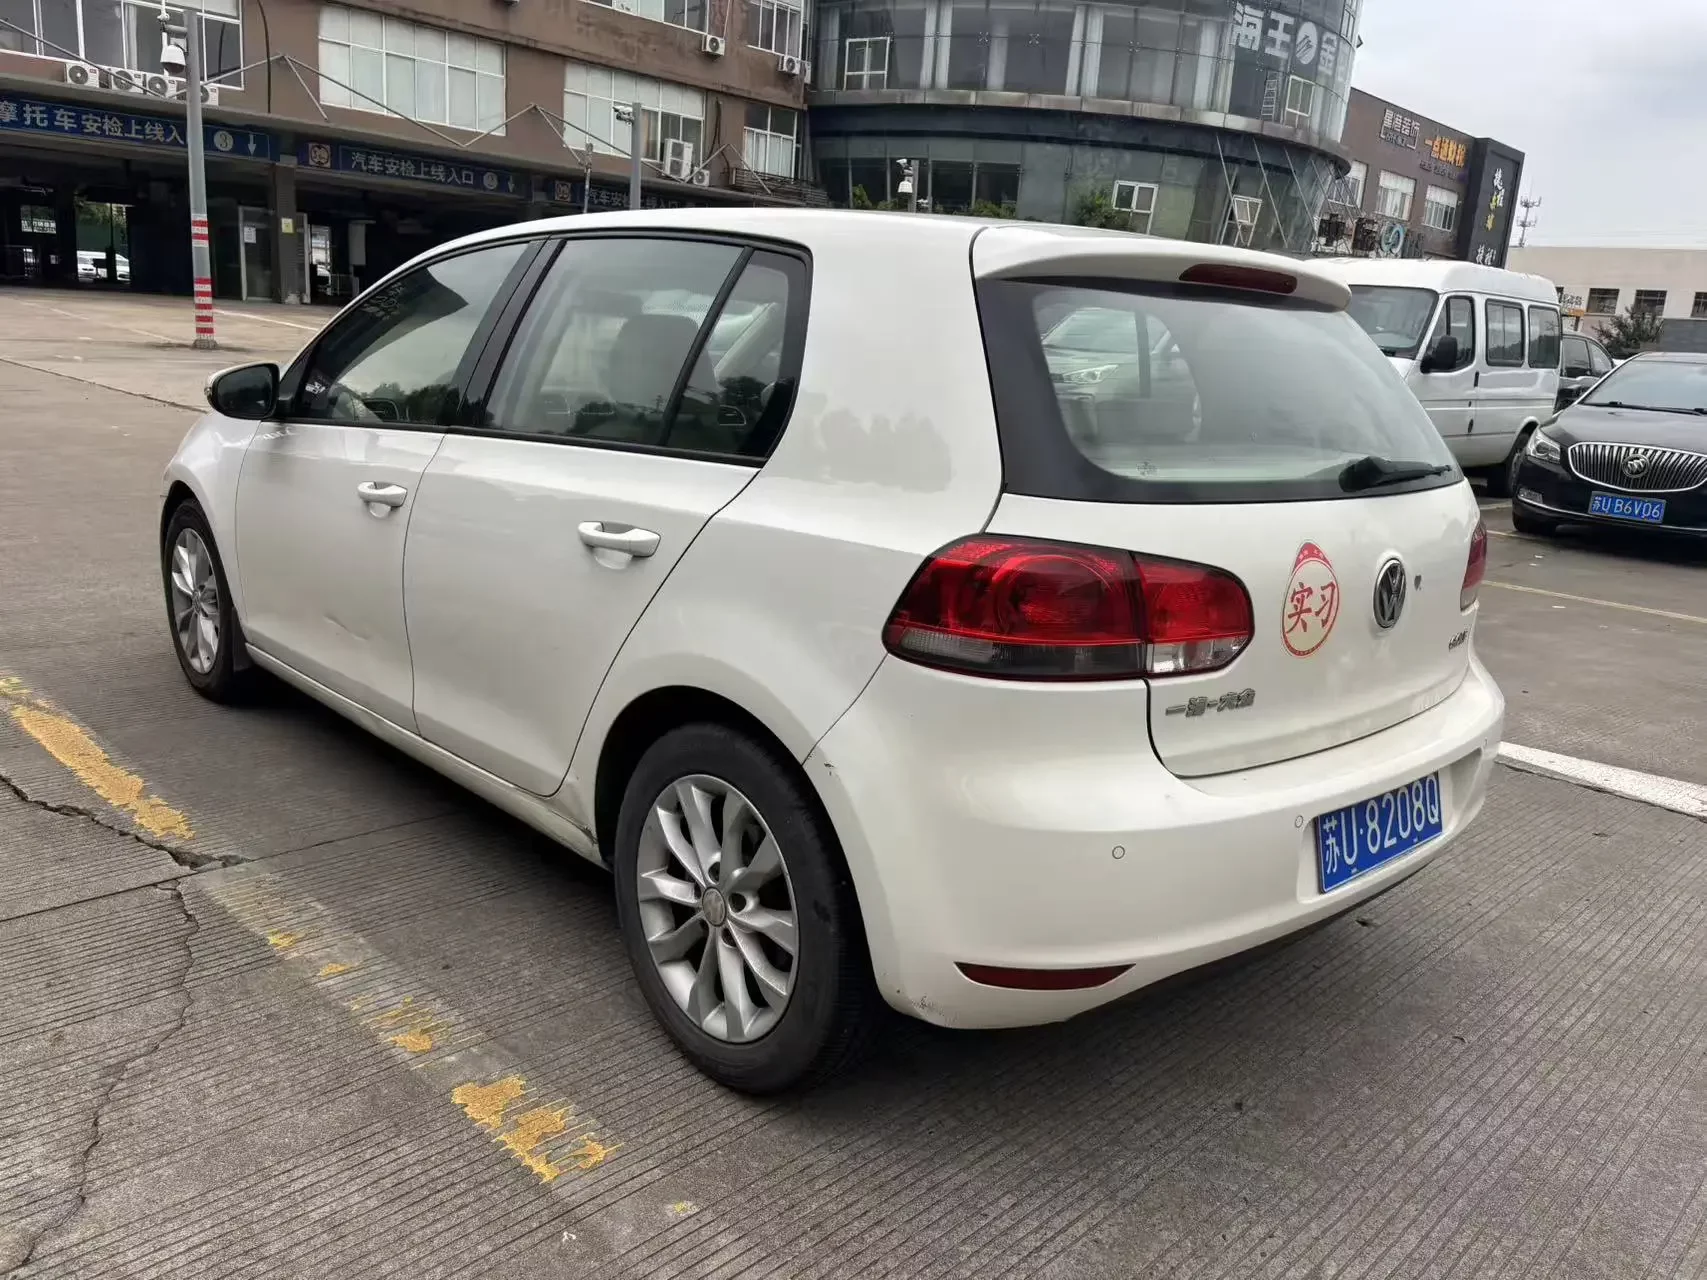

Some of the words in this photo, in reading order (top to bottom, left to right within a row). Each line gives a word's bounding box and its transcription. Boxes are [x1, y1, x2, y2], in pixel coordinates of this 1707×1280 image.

[0, 100, 185, 145] 摩托车安检上线入
[350, 150, 475, 186] 汽车安检上线入口
[1286, 581, 1336, 634] 实习
